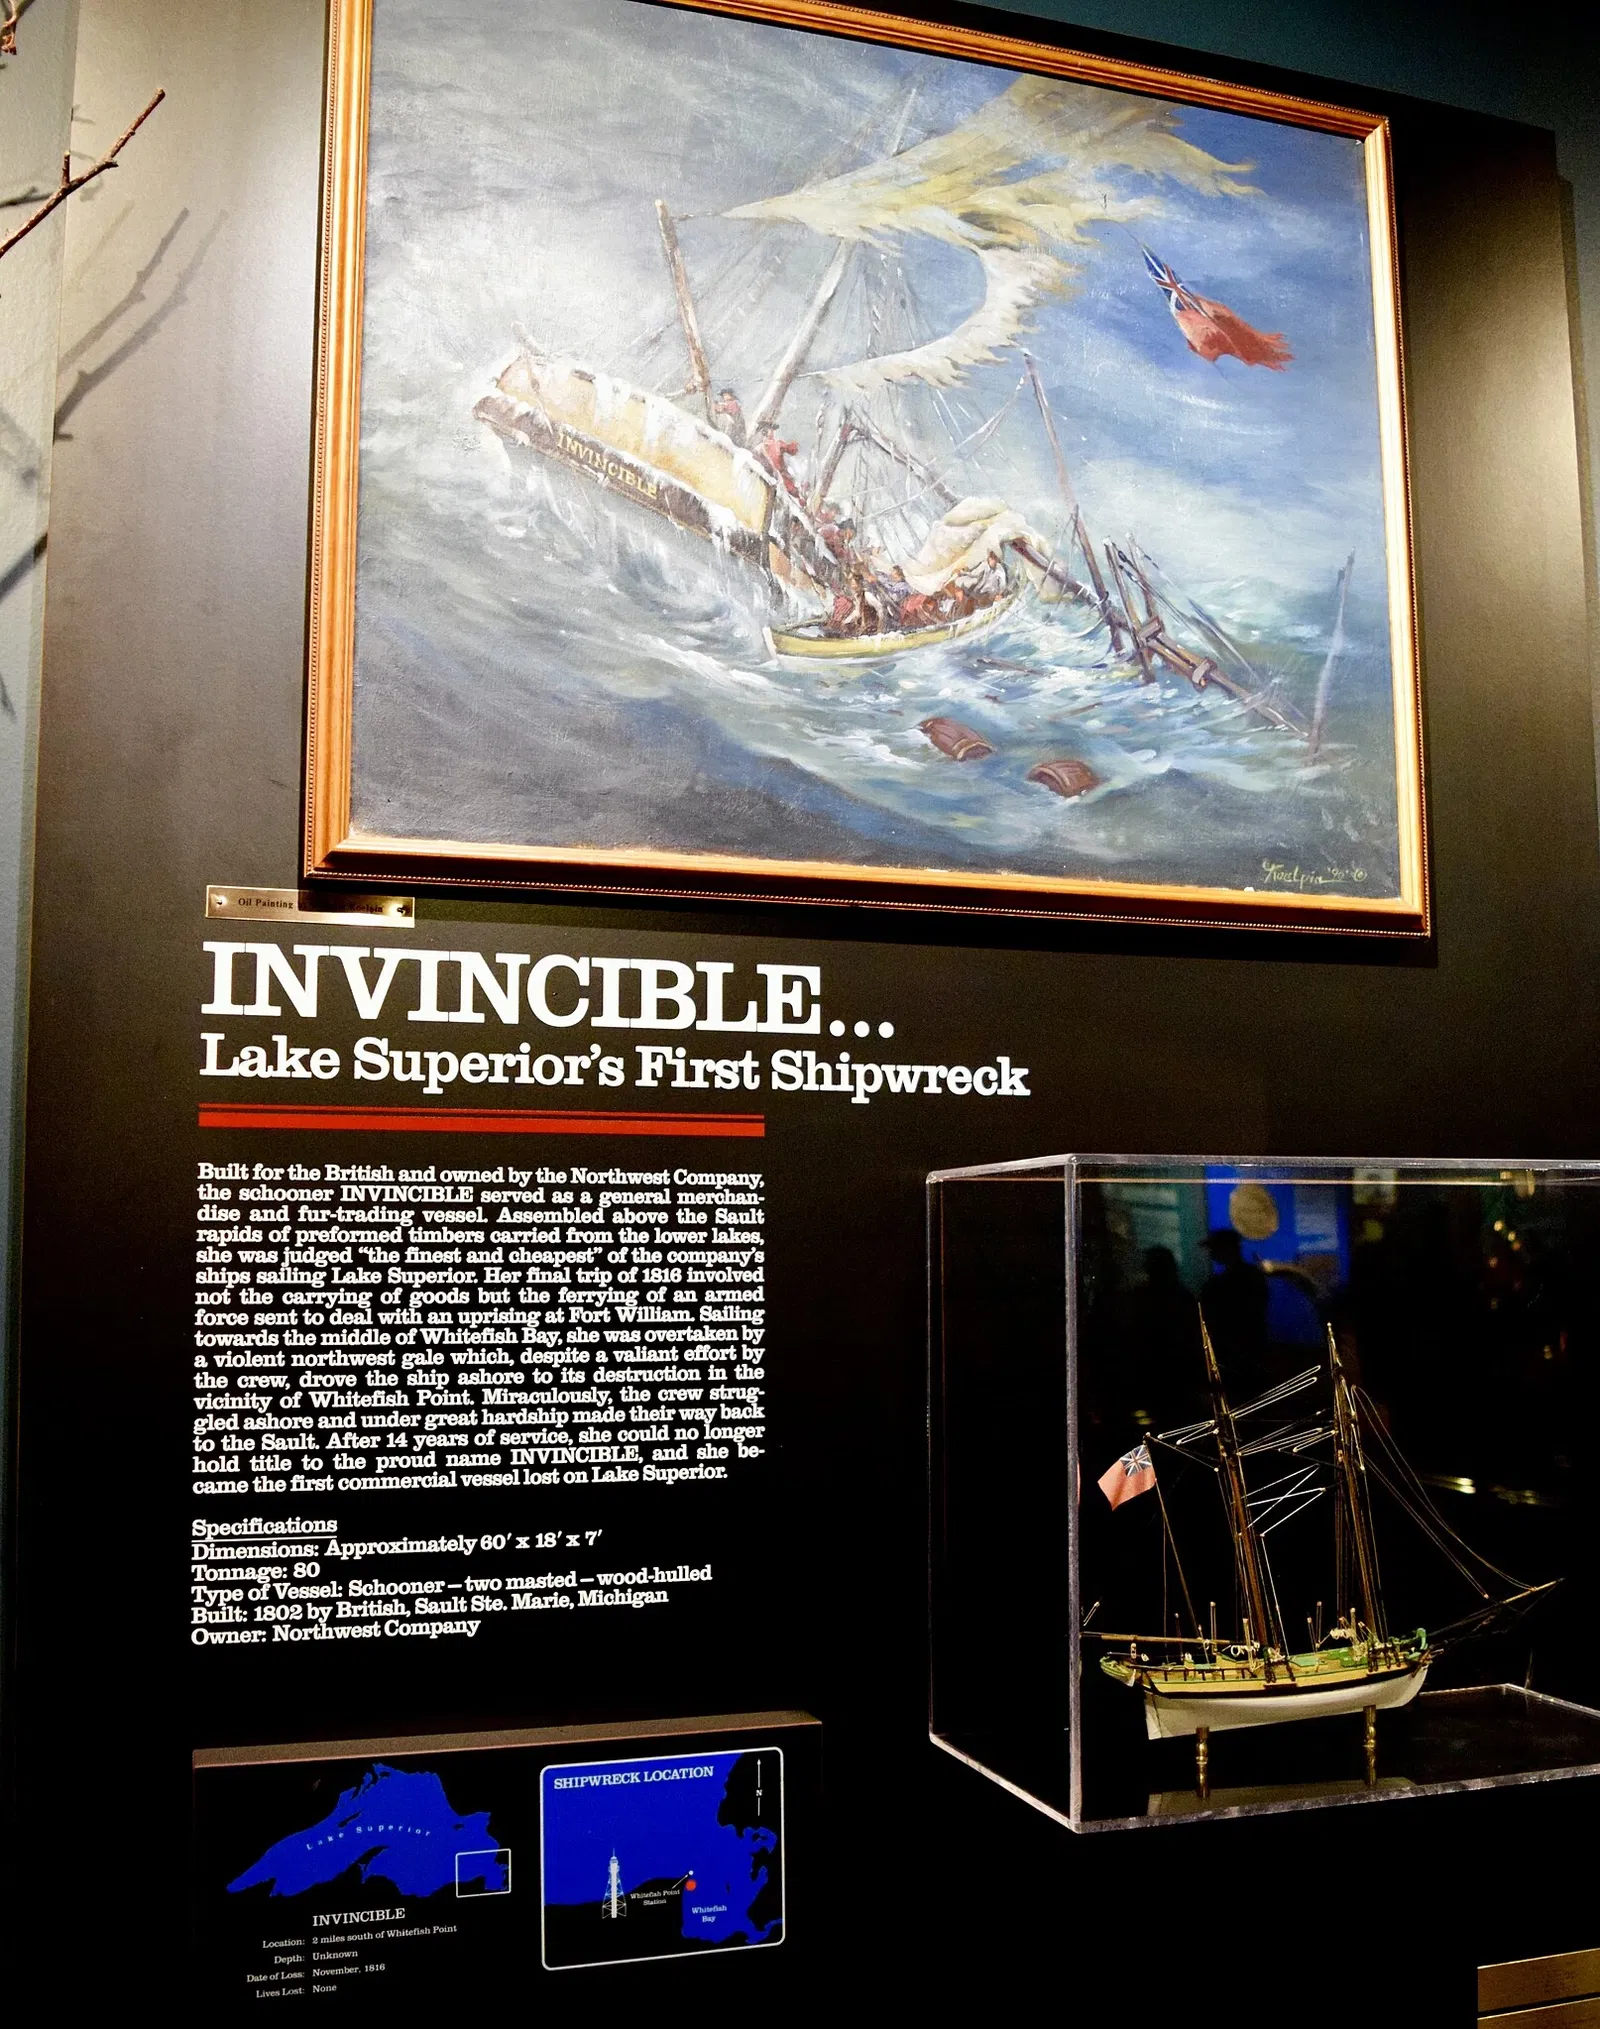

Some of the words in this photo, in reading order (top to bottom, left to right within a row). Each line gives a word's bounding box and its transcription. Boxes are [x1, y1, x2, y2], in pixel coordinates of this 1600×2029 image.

[557, 432, 658, 500] INVINCIBLE
[238, 897, 252, 907] Oil
[255, 898, 294, 909] Painting
[201, 941, 895, 1039] INVINCIBLE...
[200, 1032, 340, 1079] Lake
[353, 1037, 625, 1094] Superior's
[635, 1045, 760, 1090] First
[770, 1049, 1031, 1104] Shipwreck
[197, 1163, 249, 1180] Built
[252, 1164, 285, 1180] for
[287, 1164, 321, 1181] the
[324, 1165, 395, 1181] British
[398, 1166, 436, 1182] and
[440, 1167, 505, 1183] owned
[508, 1167, 533, 1187] by
[535, 1167, 567, 1183] the
[570, 1168, 670, 1185] Northwest
[674, 1169, 764, 1190] Company,
[197, 1205, 240, 1221] dise
[249, 1205, 290, 1222] and
[298, 1205, 415, 1227] fur-trading
[422, 1206, 488, 1223] vessel.
[496, 1206, 605, 1223] Assembled
[612, 1207, 668, 1224] above
[676, 1208, 707, 1224] the
[715, 1208, 765, 1224] Sault
[196, 1246, 232, 1263] she
[237, 1251, 278, 1263] was
[283, 1246, 353, 1268] judged
[359, 1247, 400, 1263] "the
[405, 1246, 461, 1263] finest
[466, 1247, 504, 1263] and
[509, 1247, 603, 1268] cheapest"
[607, 1247, 629, 1263] of
[631, 1247, 662, 1263] the
[667, 1247, 764, 1268] company's
[195, 1289, 231, 1305] not
[239, 1288, 273, 1304] the
[282, 1287, 373, 1309] carrying
[380, 1287, 403, 1304] of
[410, 1287, 470, 1308] goods
[478, 1287, 510, 1303] but
[518, 1287, 550, 1303] the
[558, 1286, 639, 1308] ferrying
[646, 1286, 667, 1302] of
[673, 1290, 698, 1302] an
[705, 1286, 765, 1302] armed
[194, 1329, 279, 1346] towards
[282, 1329, 316, 1346] the
[320, 1329, 391, 1345] middle
[395, 1328, 418, 1345] of
[420, 1326, 518, 1344] Whitefish
[521, 1326, 562, 1348] Bay,
[567, 1327, 600, 1343] she
[603, 1330, 641, 1342] was
[644, 1325, 739, 1342] overtaken
[742, 1324, 765, 1346] by
[193, 1372, 228, 1389] the
[237, 1376, 290, 1390] crew,
[299, 1371, 357, 1387] drove
[365, 1370, 398, 1386] the
[407, 1368, 449, 1389] ship
[458, 1368, 524, 1385] ashore
[532, 1366, 553, 1384] to
[561, 1367, 585, 1383] its
[593, 1365, 701, 1383] destruction
[708, 1365, 728, 1380] in
[734, 1362, 764, 1380] the
[194, 1413, 239, 1435] gled
[243, 1412, 313, 1430] ashore
[318, 1411, 357, 1428] and
[361, 1411, 421, 1428] under
[425, 1410, 478, 1430] great
[481, 1408, 569, 1428] hardship
[572, 1405, 625, 1423] made
[629, 1405, 676, 1421] their
[678, 1408, 717, 1425] way
[720, 1402, 765, 1419] back
[192, 1455, 240, 1473] hold
[249, 1455, 292, 1471] title
[301, 1455, 323, 1470] to
[332, 1453, 366, 1470] the
[376, 1450, 437, 1473] proud
[446, 1454, 501, 1466] name
[510, 1445, 643, 1465] INVINCIBLE,
[652, 1444, 688, 1461] and
[697, 1443, 729, 1459] she
[737, 1441, 765, 1458] be-
[191, 1517, 338, 1540] Specifications
[191, 1541, 319, 1560] Dimensions:
[324, 1534, 478, 1560] Approximately
[515, 1536, 530, 1549] x
[566, 1534, 580, 1547] x
[191, 1564, 288, 1584] Tonnage:
[293, 1562, 320, 1578] 80
[191, 1585, 244, 1607] Type
[248, 1584, 271, 1601] of
[273, 1581, 343, 1600] Vessel:
[348, 1579, 446, 1597] Schooner
[464, 1575, 501, 1592] two
[505, 1570, 577, 1590] masted
[596, 1564, 713, 1586] wood-hulled
[191, 1606, 248, 1624] Built:
[253, 1604, 303, 1622] 1802
[307, 1602, 333, 1623] by
[335, 1599, 411, 1618] British,
[414, 1596, 468, 1615] Sault
[470, 1595, 508, 1613] Ste.
[511, 1592, 574, 1610] Marie,
[577, 1588, 669, 1608] Michigan
[191, 1628, 267, 1646] Owner:
[272, 1621, 381, 1642] Northwest
[384, 1619, 481, 1639] Company
[554, 1772, 641, 1789] SHIPWRECK
[643, 1766, 714, 1782] LOCATION
[755, 1789, 763, 1797] N
[306, 1832, 344, 1850] Lake
[356, 1824, 430, 1837] Superior
[630, 1890, 662, 1899] Whitefish
[312, 1907, 406, 1927] INVINCIBLE
[691, 1905, 727, 1914] Whitefish
[702, 1915, 716, 1923] Bay
[262, 1937, 305, 1949] Location:
[312, 1936, 319, 1945] 2
[320, 1934, 345, 1944] miles
[347, 1931, 374, 1942] south
[375, 1930, 385, 1940] of
[386, 1926, 431, 1938] Whitefish
[433, 1924, 457, 1934] Point
[274, 1954, 305, 1966] Depth:
[312, 1949, 358, 1961] Unknown
[246, 1973, 268, 1983] Date
[269, 1972, 279, 1981] of
[281, 1970, 305, 1980] Loss:
[364, 1963, 386, 1972] 1816
[256, 1988, 280, 1998] Lives
[282, 1986, 305, 1996] Lost:
[312, 1984, 337, 1993] None
